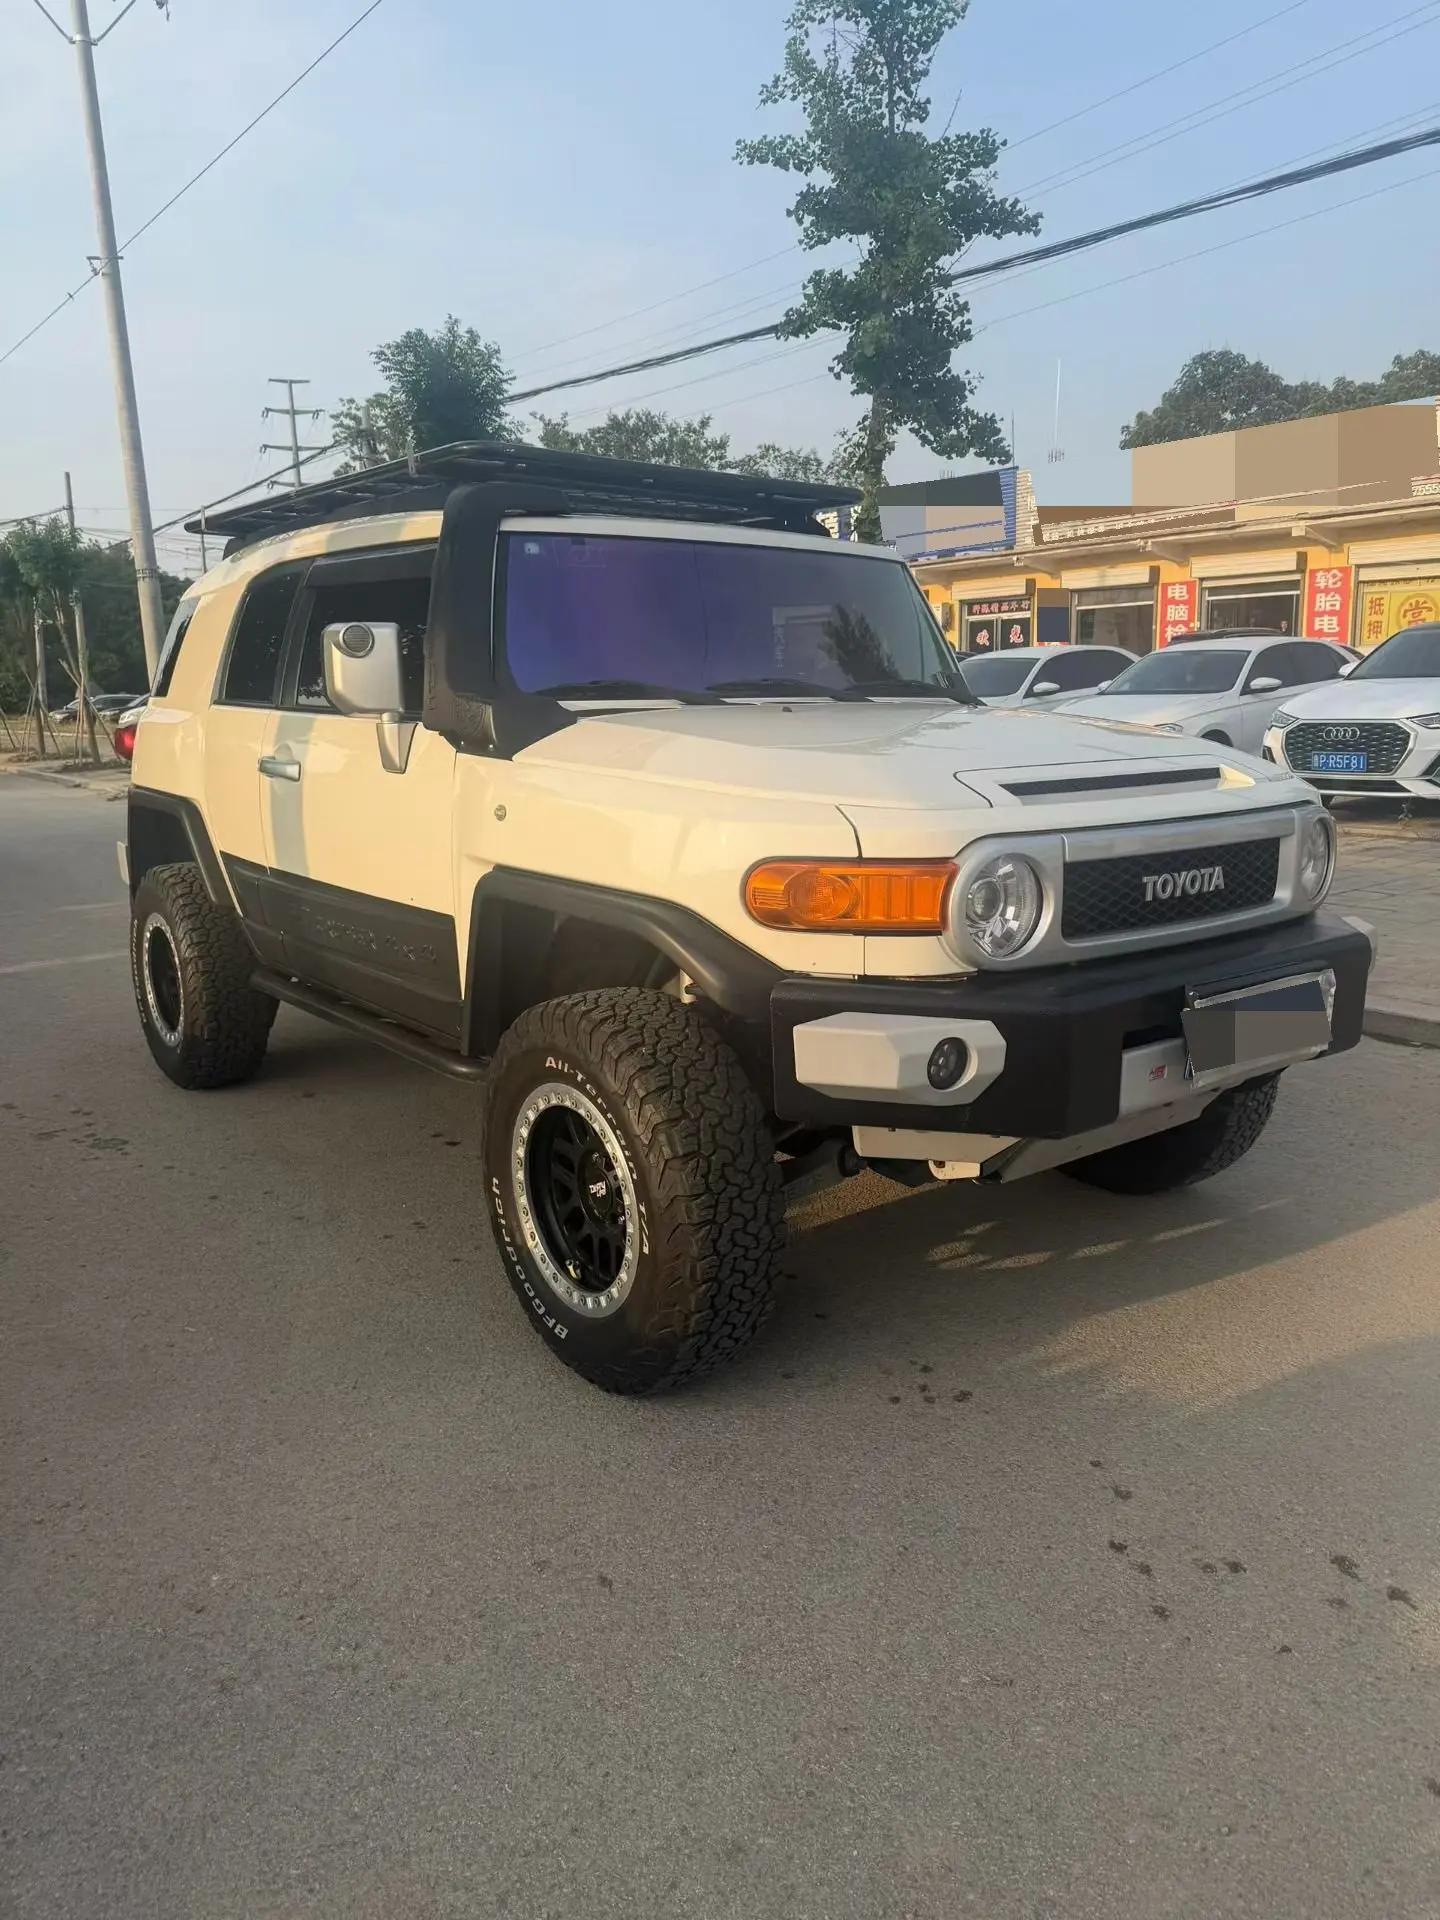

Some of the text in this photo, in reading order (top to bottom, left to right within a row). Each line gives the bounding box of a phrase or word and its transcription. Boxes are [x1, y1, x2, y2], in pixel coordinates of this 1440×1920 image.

[1313, 569, 1342, 641] 轮胎电
[1367, 596, 1385, 640] 抵押
[1142, 866, 1225, 902] TOYOTA
